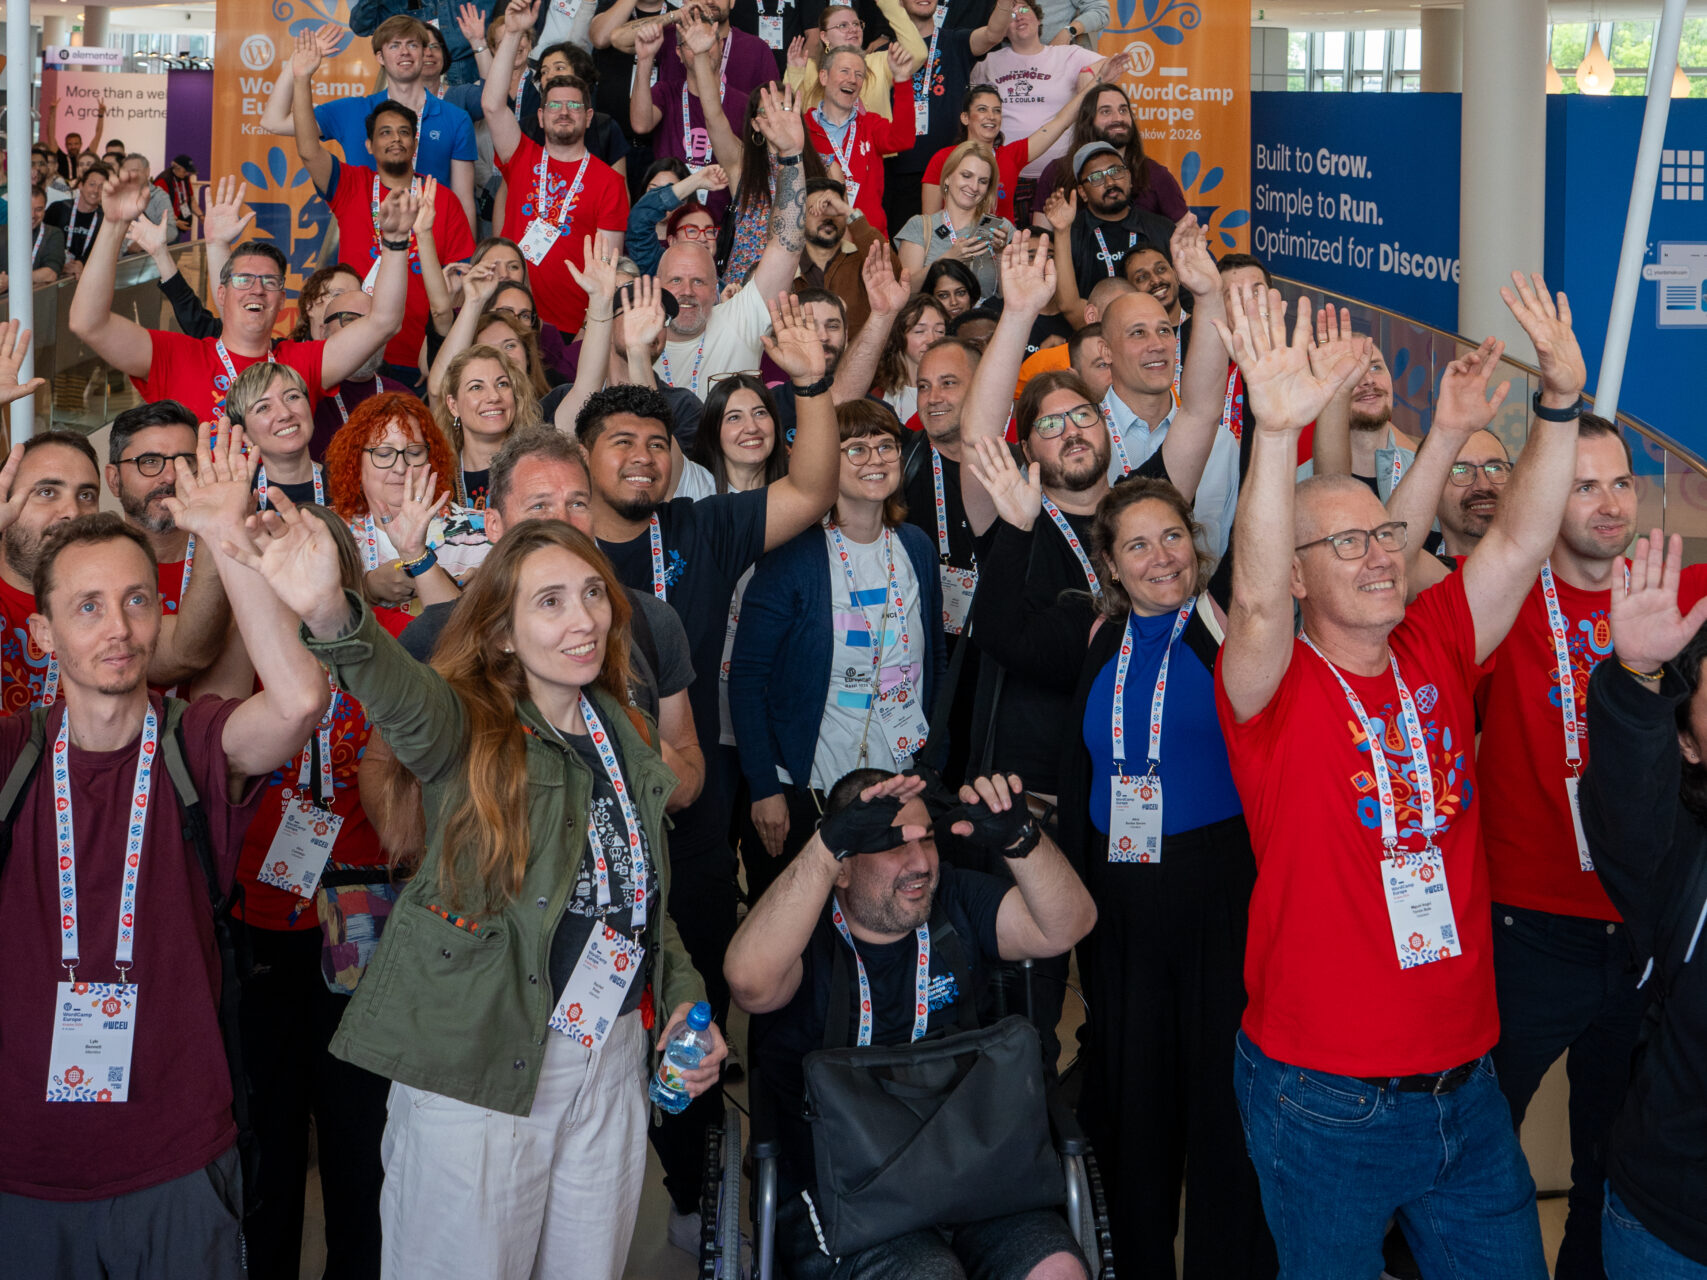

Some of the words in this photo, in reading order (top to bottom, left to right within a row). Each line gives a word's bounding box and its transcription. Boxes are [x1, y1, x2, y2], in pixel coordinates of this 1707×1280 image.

[72, 50, 118, 60] elementor
[66, 85, 100, 98] More
[103, 86, 132, 99] than
[136, 90, 143, 99] a
[240, 77, 365, 97] Woamp
[1121, 82, 1233, 106] WordCamp
[65, 106, 74, 117] A
[1169, 128, 1202, 140] 2026
[1256, 143, 1291, 172] Built
[1296, 147, 1313, 173] to
[1317, 147, 1372, 179] Grow.
[1255, 183, 1313, 223] Simple
[1317, 191, 1336, 219] to
[1340, 193, 1383, 225] Run.
[1255, 226, 1342, 264] Optimized
[1348, 236, 1374, 269] for
[103, 1021, 128, 1030] #WCEU
